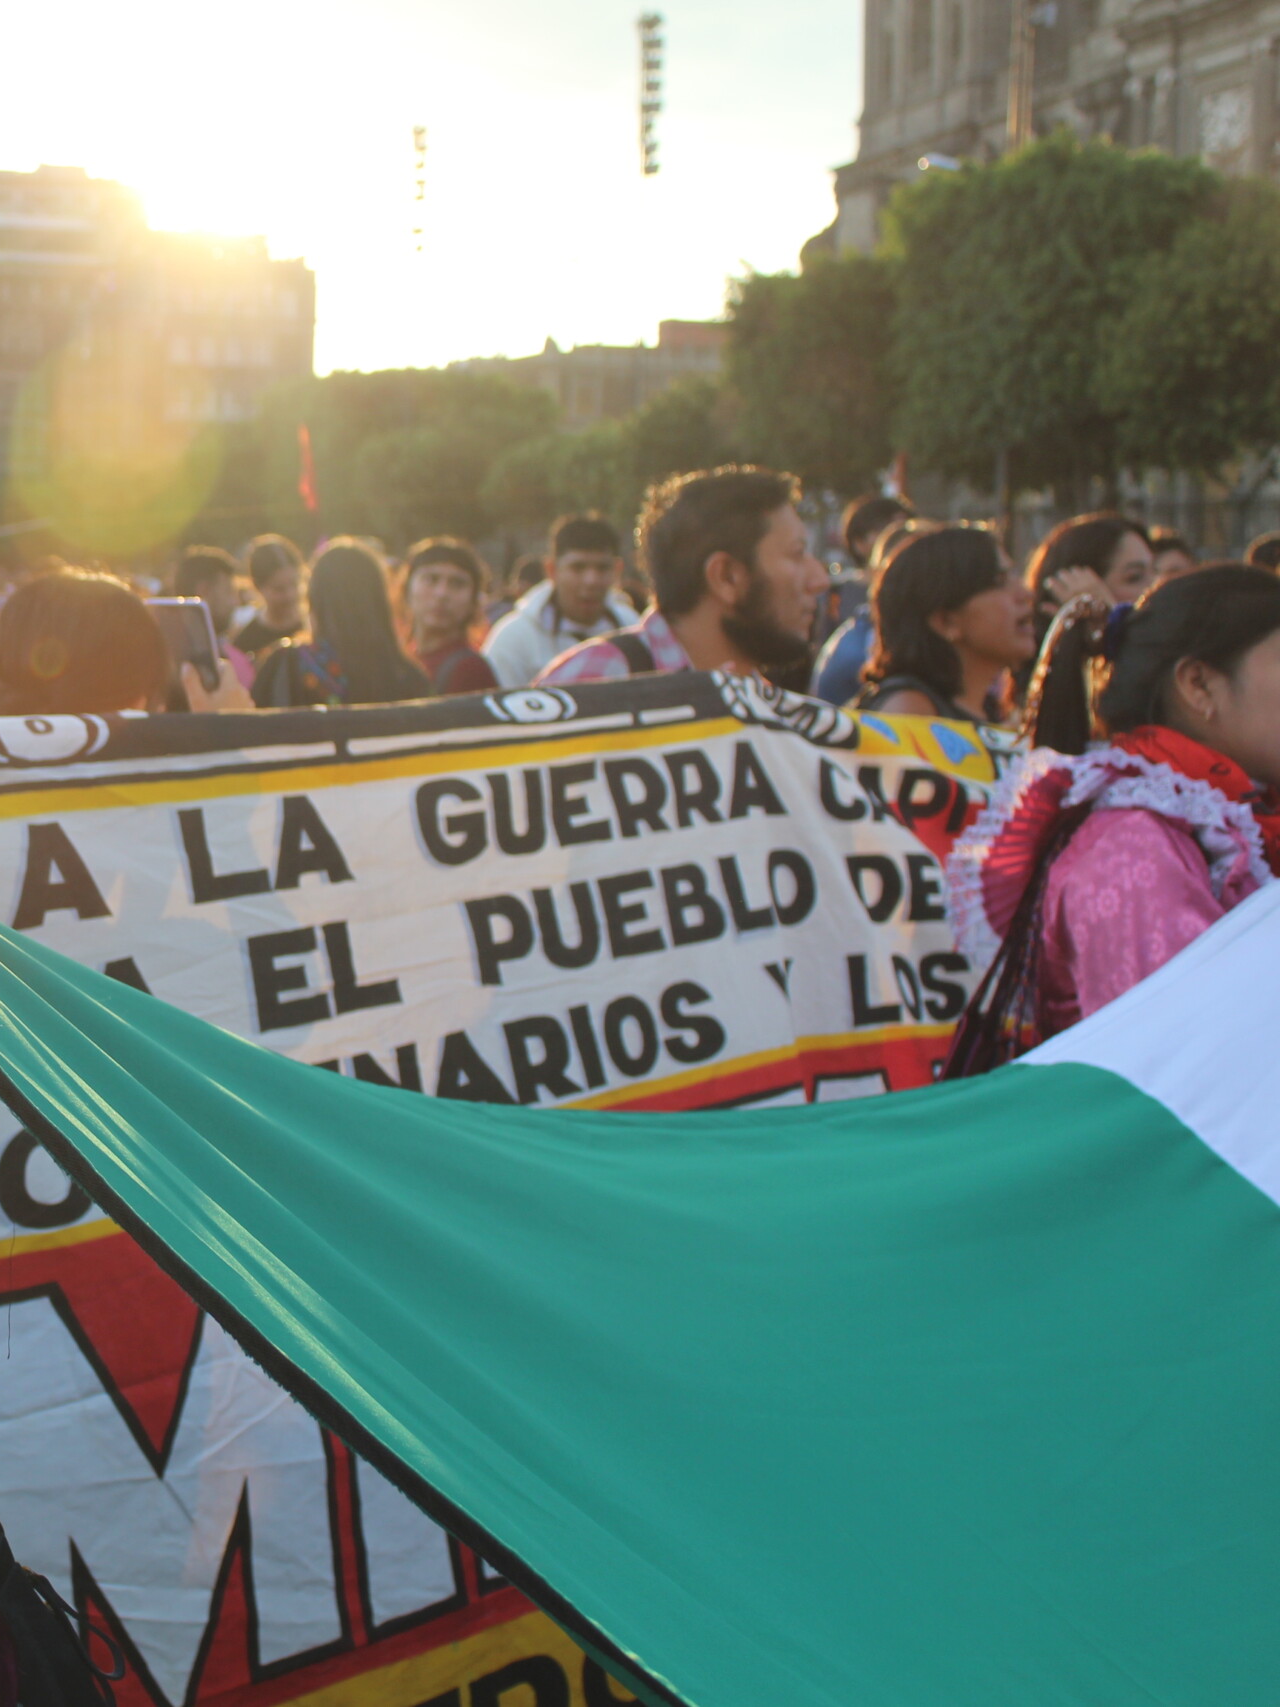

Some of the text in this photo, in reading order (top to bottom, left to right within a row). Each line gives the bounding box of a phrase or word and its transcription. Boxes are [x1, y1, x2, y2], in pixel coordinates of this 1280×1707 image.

[12, 822, 113, 930] A
[176, 796, 354, 904] LA
[415, 740, 788, 866] GUERRA
[247, 849, 947, 1032] EL PUEBLO DE
[846, 952, 971, 1027] LOS
